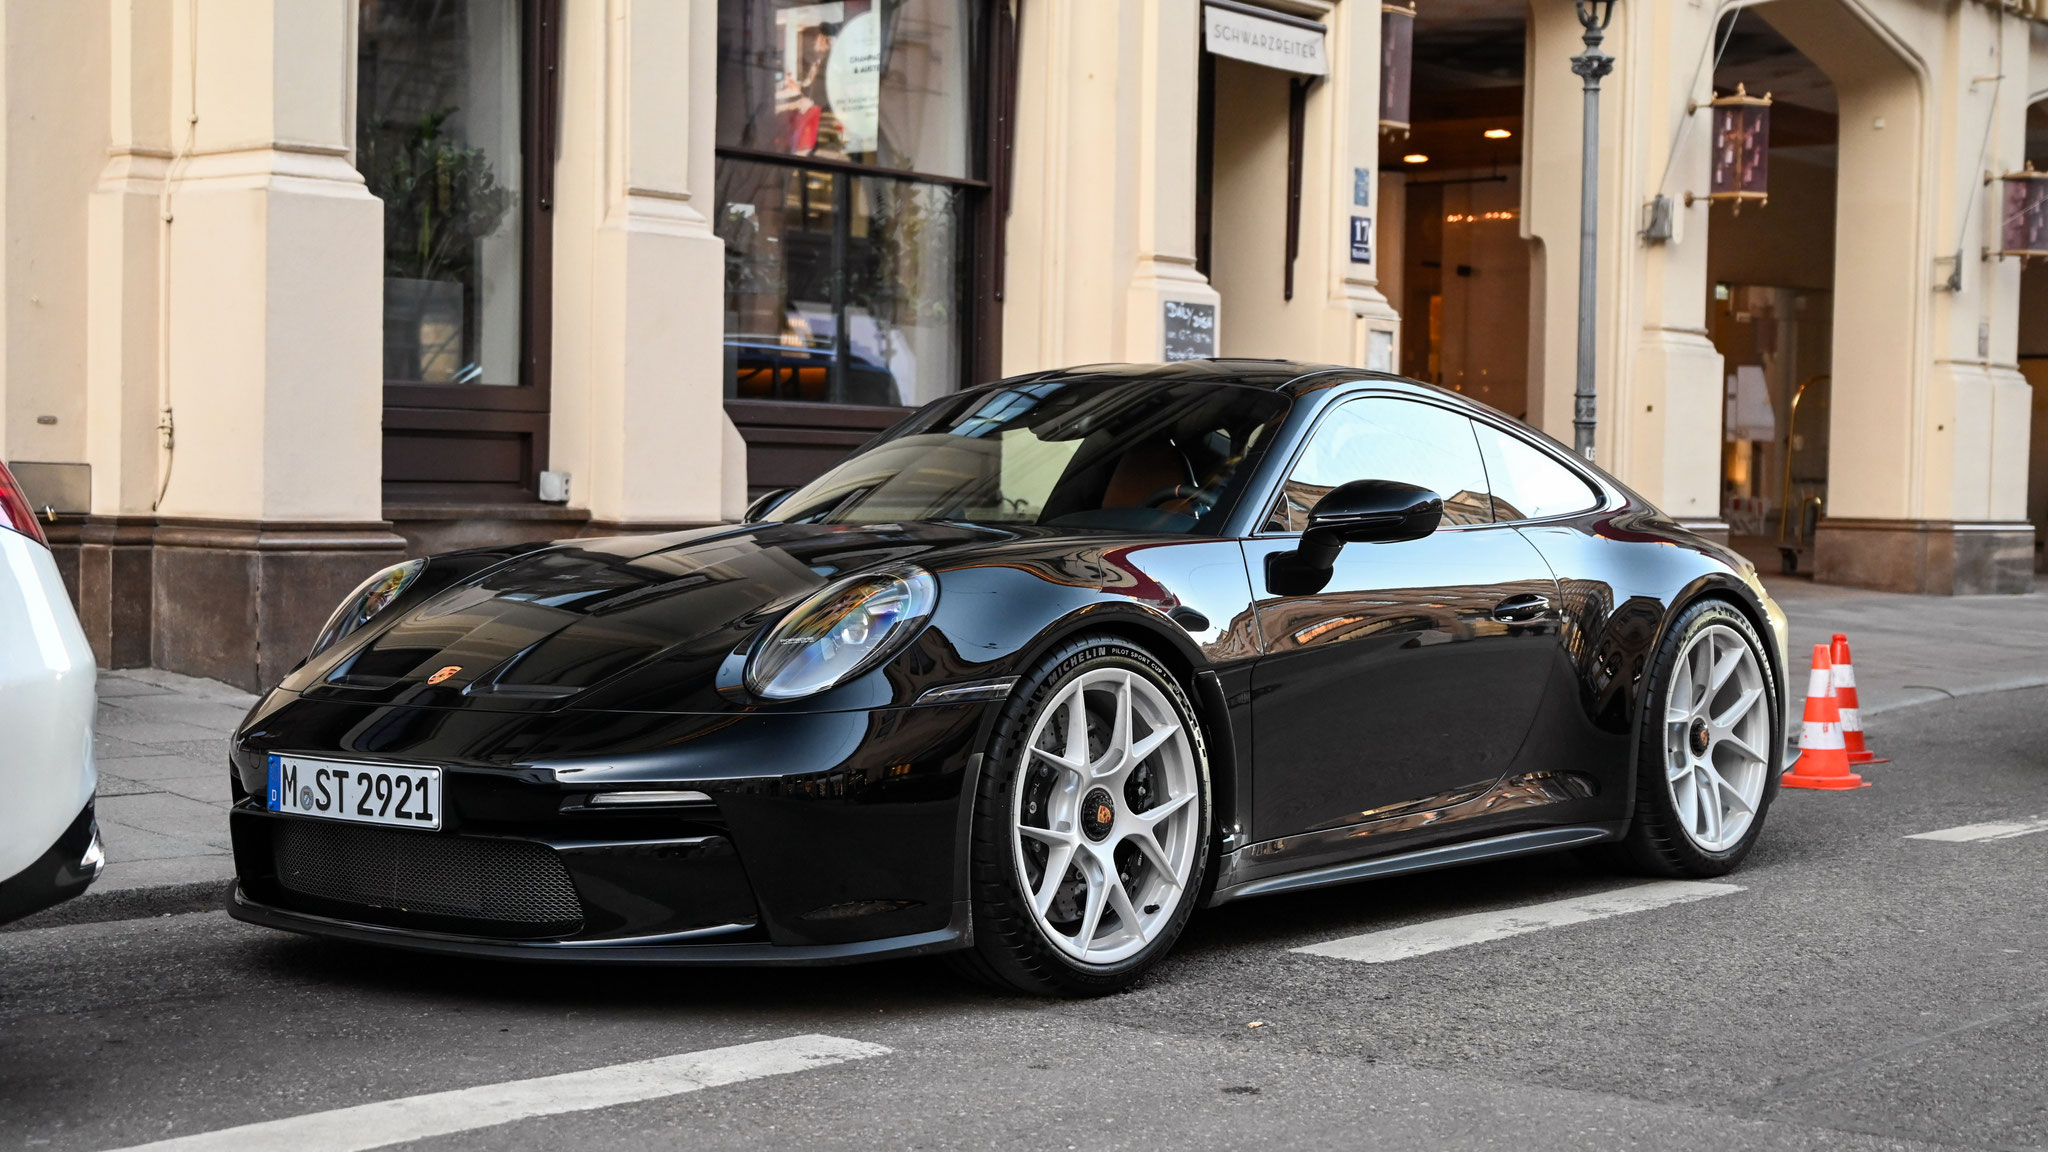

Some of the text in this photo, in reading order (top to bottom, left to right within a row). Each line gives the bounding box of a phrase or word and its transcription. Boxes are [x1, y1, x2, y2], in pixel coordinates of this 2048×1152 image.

[1214, 24, 1317, 58] SCHWARZREITER
[1355, 220, 1369, 242] 17
[1047, 646, 1163, 686] MICHELIN PILOT SPORT CUP
[271, 789, 277, 801] D
[282, 763, 433, 821] M ST 2921
